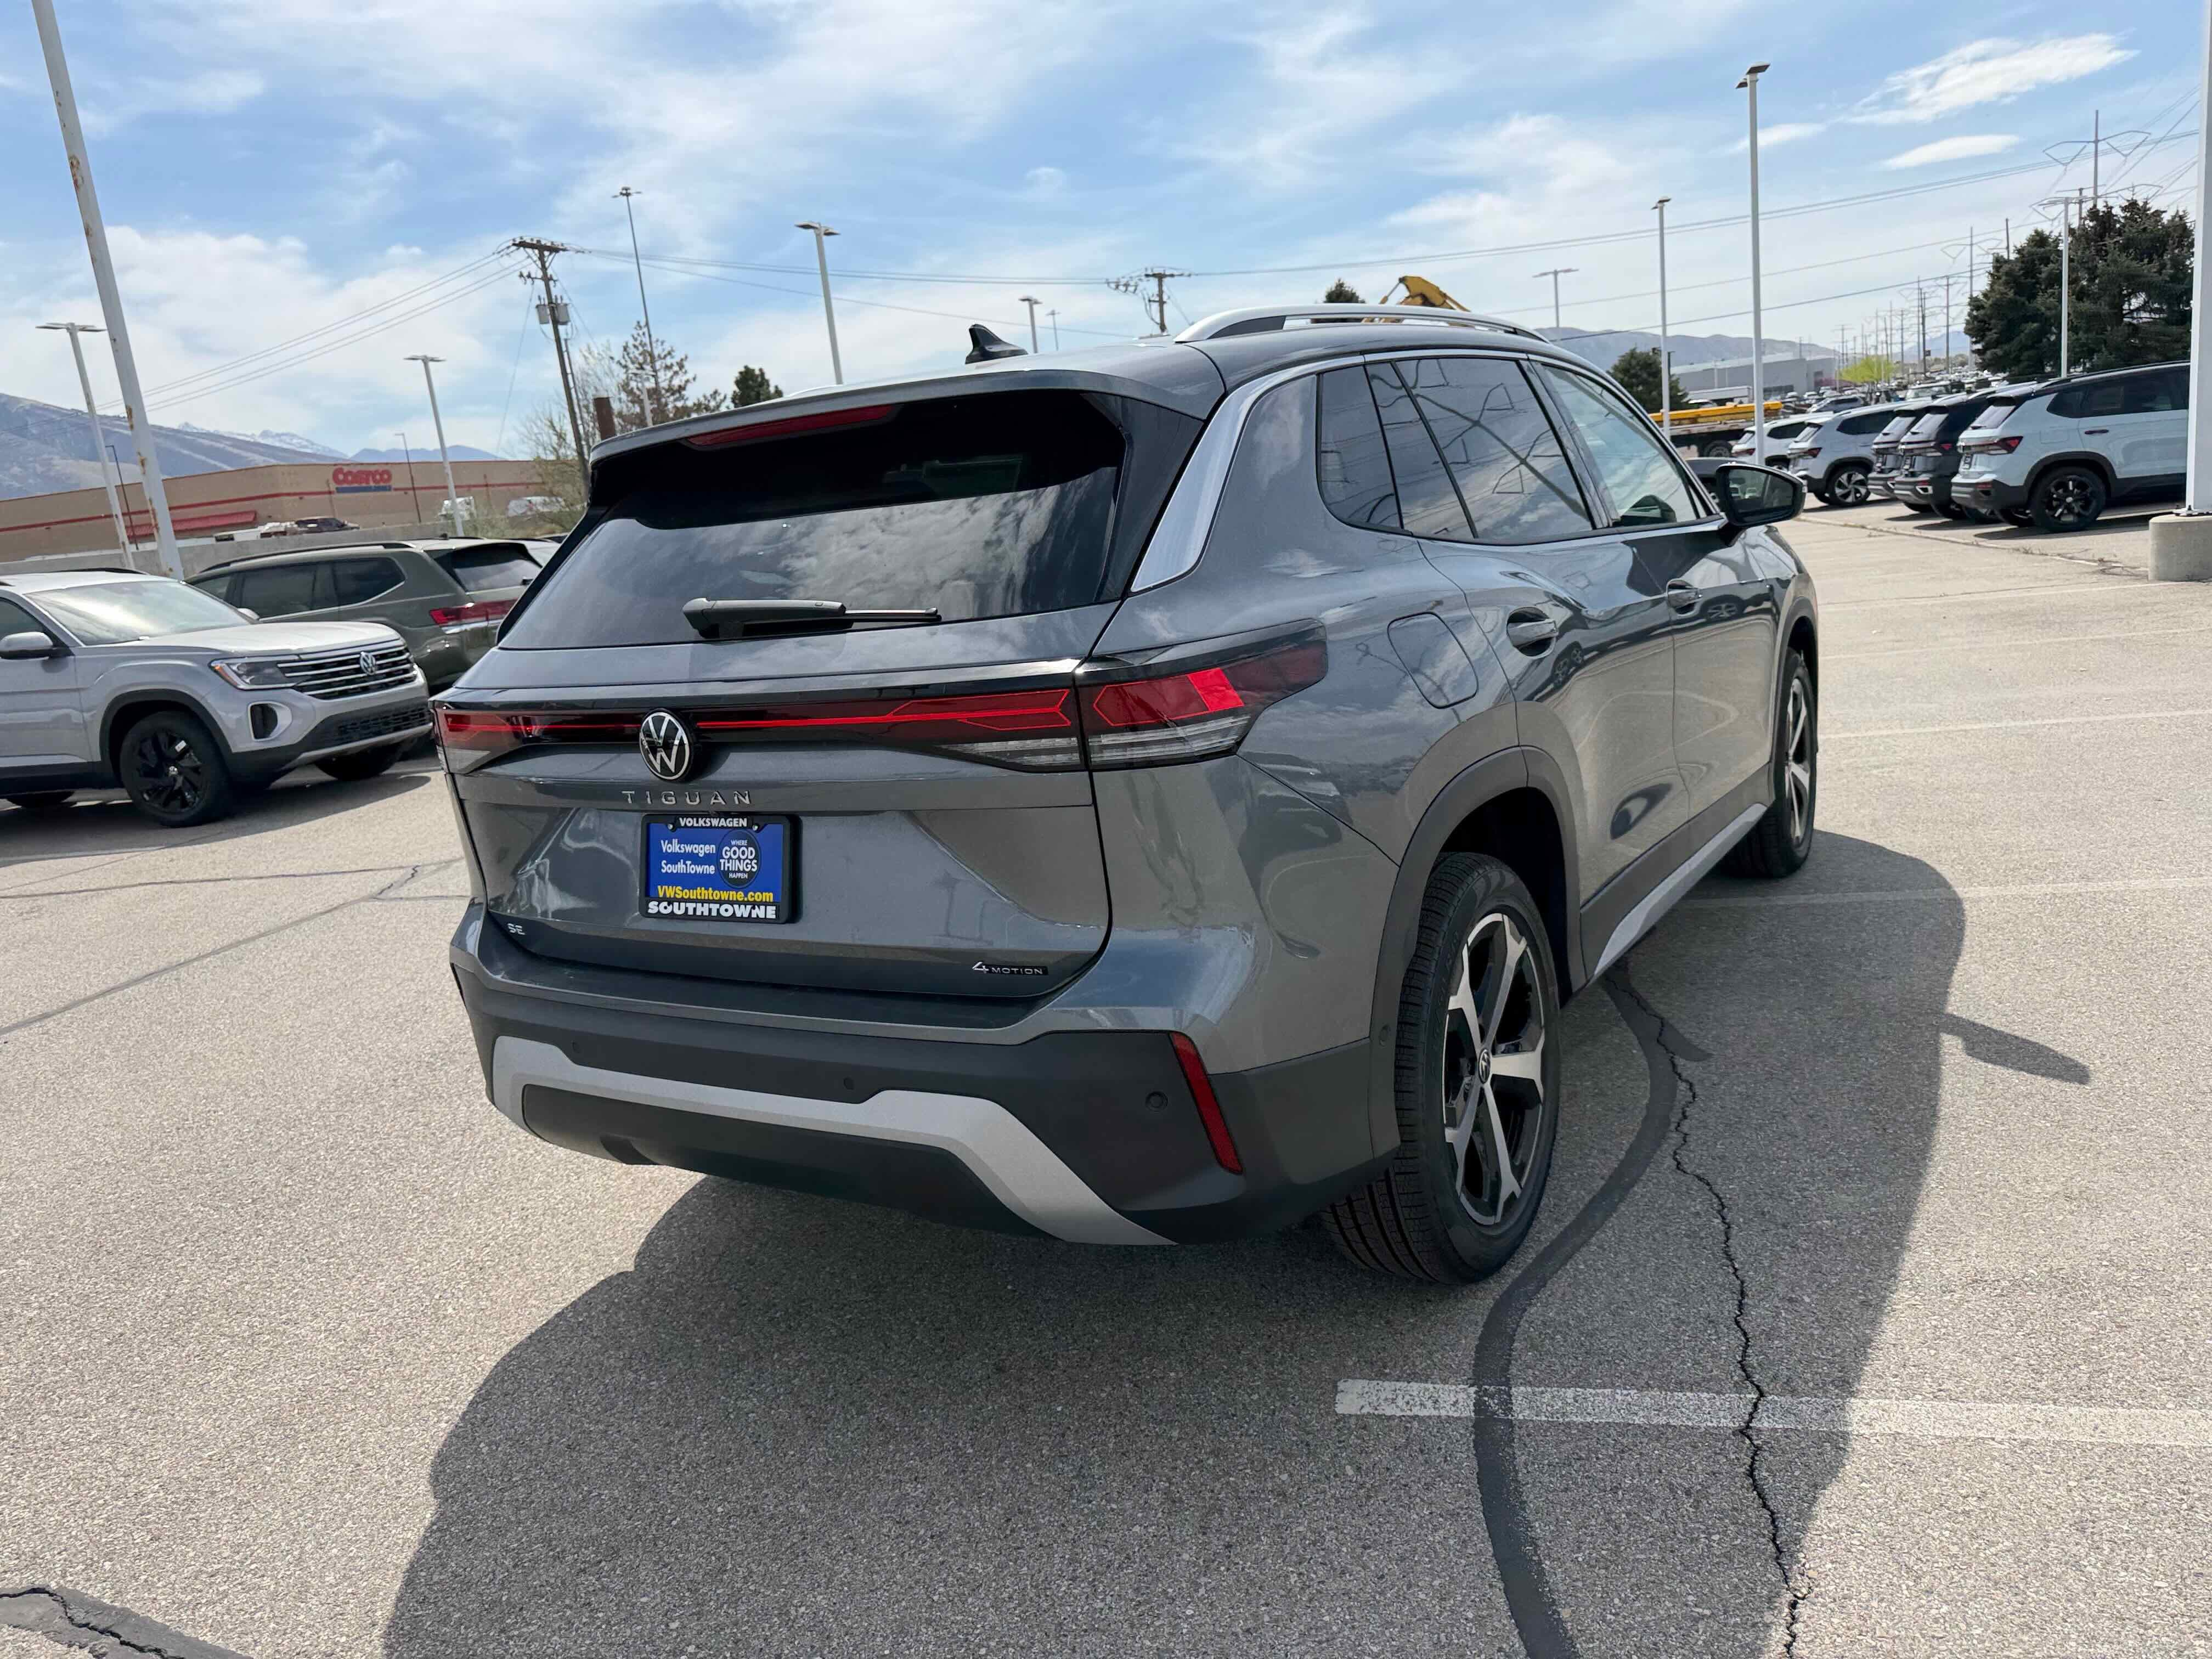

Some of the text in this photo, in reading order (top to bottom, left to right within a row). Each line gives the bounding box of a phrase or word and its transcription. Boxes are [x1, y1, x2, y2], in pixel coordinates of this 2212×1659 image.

[640, 712, 690, 780] VW
[622, 791, 751, 805] TIGUAN
[679, 817, 747, 827] VOLKSWAGEN
[661, 839, 716, 856] Volkswagen
[722, 846, 755, 859] GOOD
[661, 860, 715, 875] SouthTowne
[720, 859, 758, 872] THINGS
[658, 885, 773, 902] VWSouthtowne.com
[647, 900, 777, 918] SOUTHTOWNE
[507, 923, 525, 935] SE
[972, 962, 1043, 974] 4MOTION
